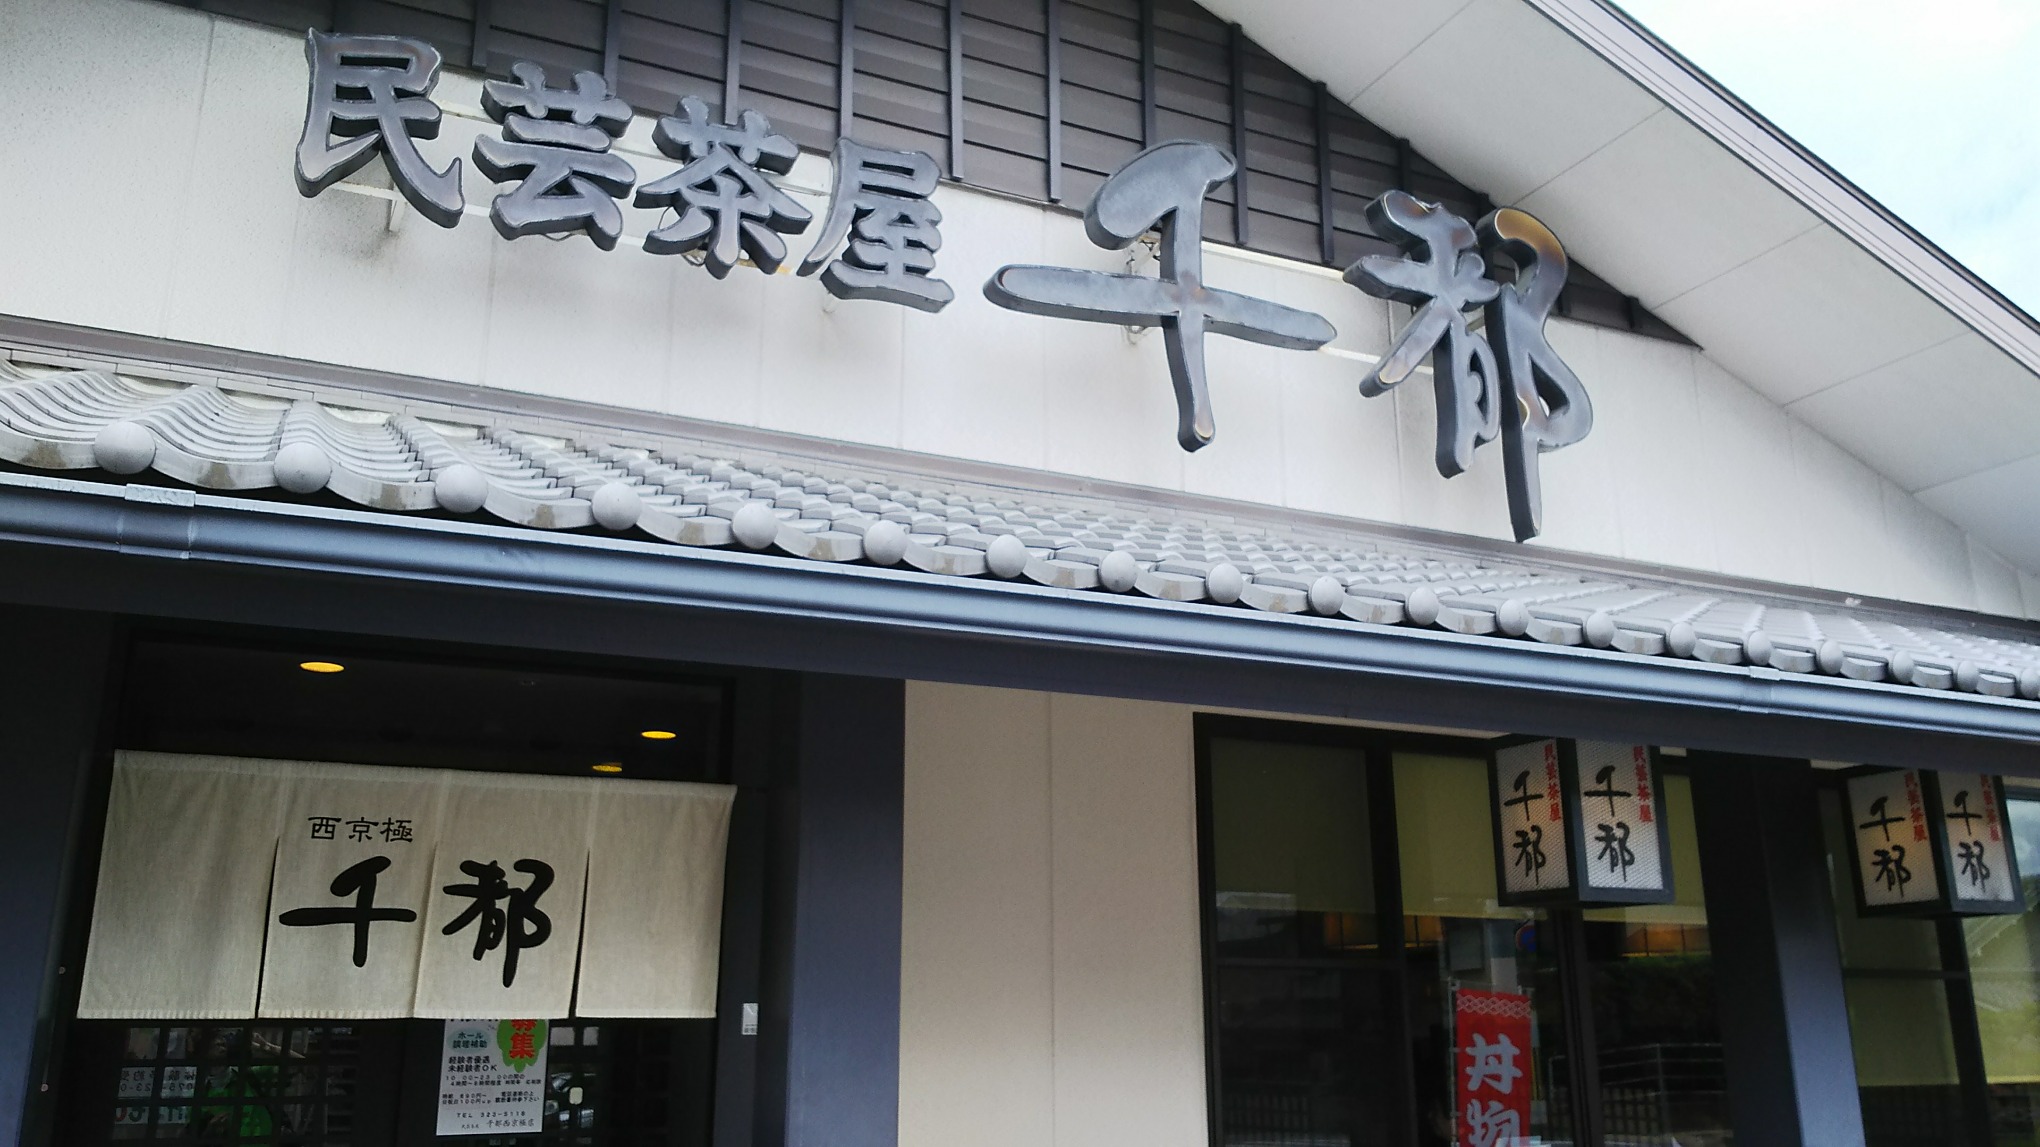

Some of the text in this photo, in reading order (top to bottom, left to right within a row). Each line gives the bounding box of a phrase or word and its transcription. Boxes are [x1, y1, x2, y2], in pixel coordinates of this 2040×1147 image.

[294, 27, 1594, 543] 民芸茶屋 千都
[307, 816, 413, 843] 西京極
[1503, 770, 1547, 885] 千都
[1583, 765, 1636, 883] 千都
[1859, 796, 1912, 898] 千都
[1945, 790, 1991, 893] 千都
[278, 855, 555, 988] 千都
[448, 1055, 490, 1065] 経験者優遇
[457, 1031, 484, 1039] ホール
[1465, 1032, 1523, 1147] 丼物
